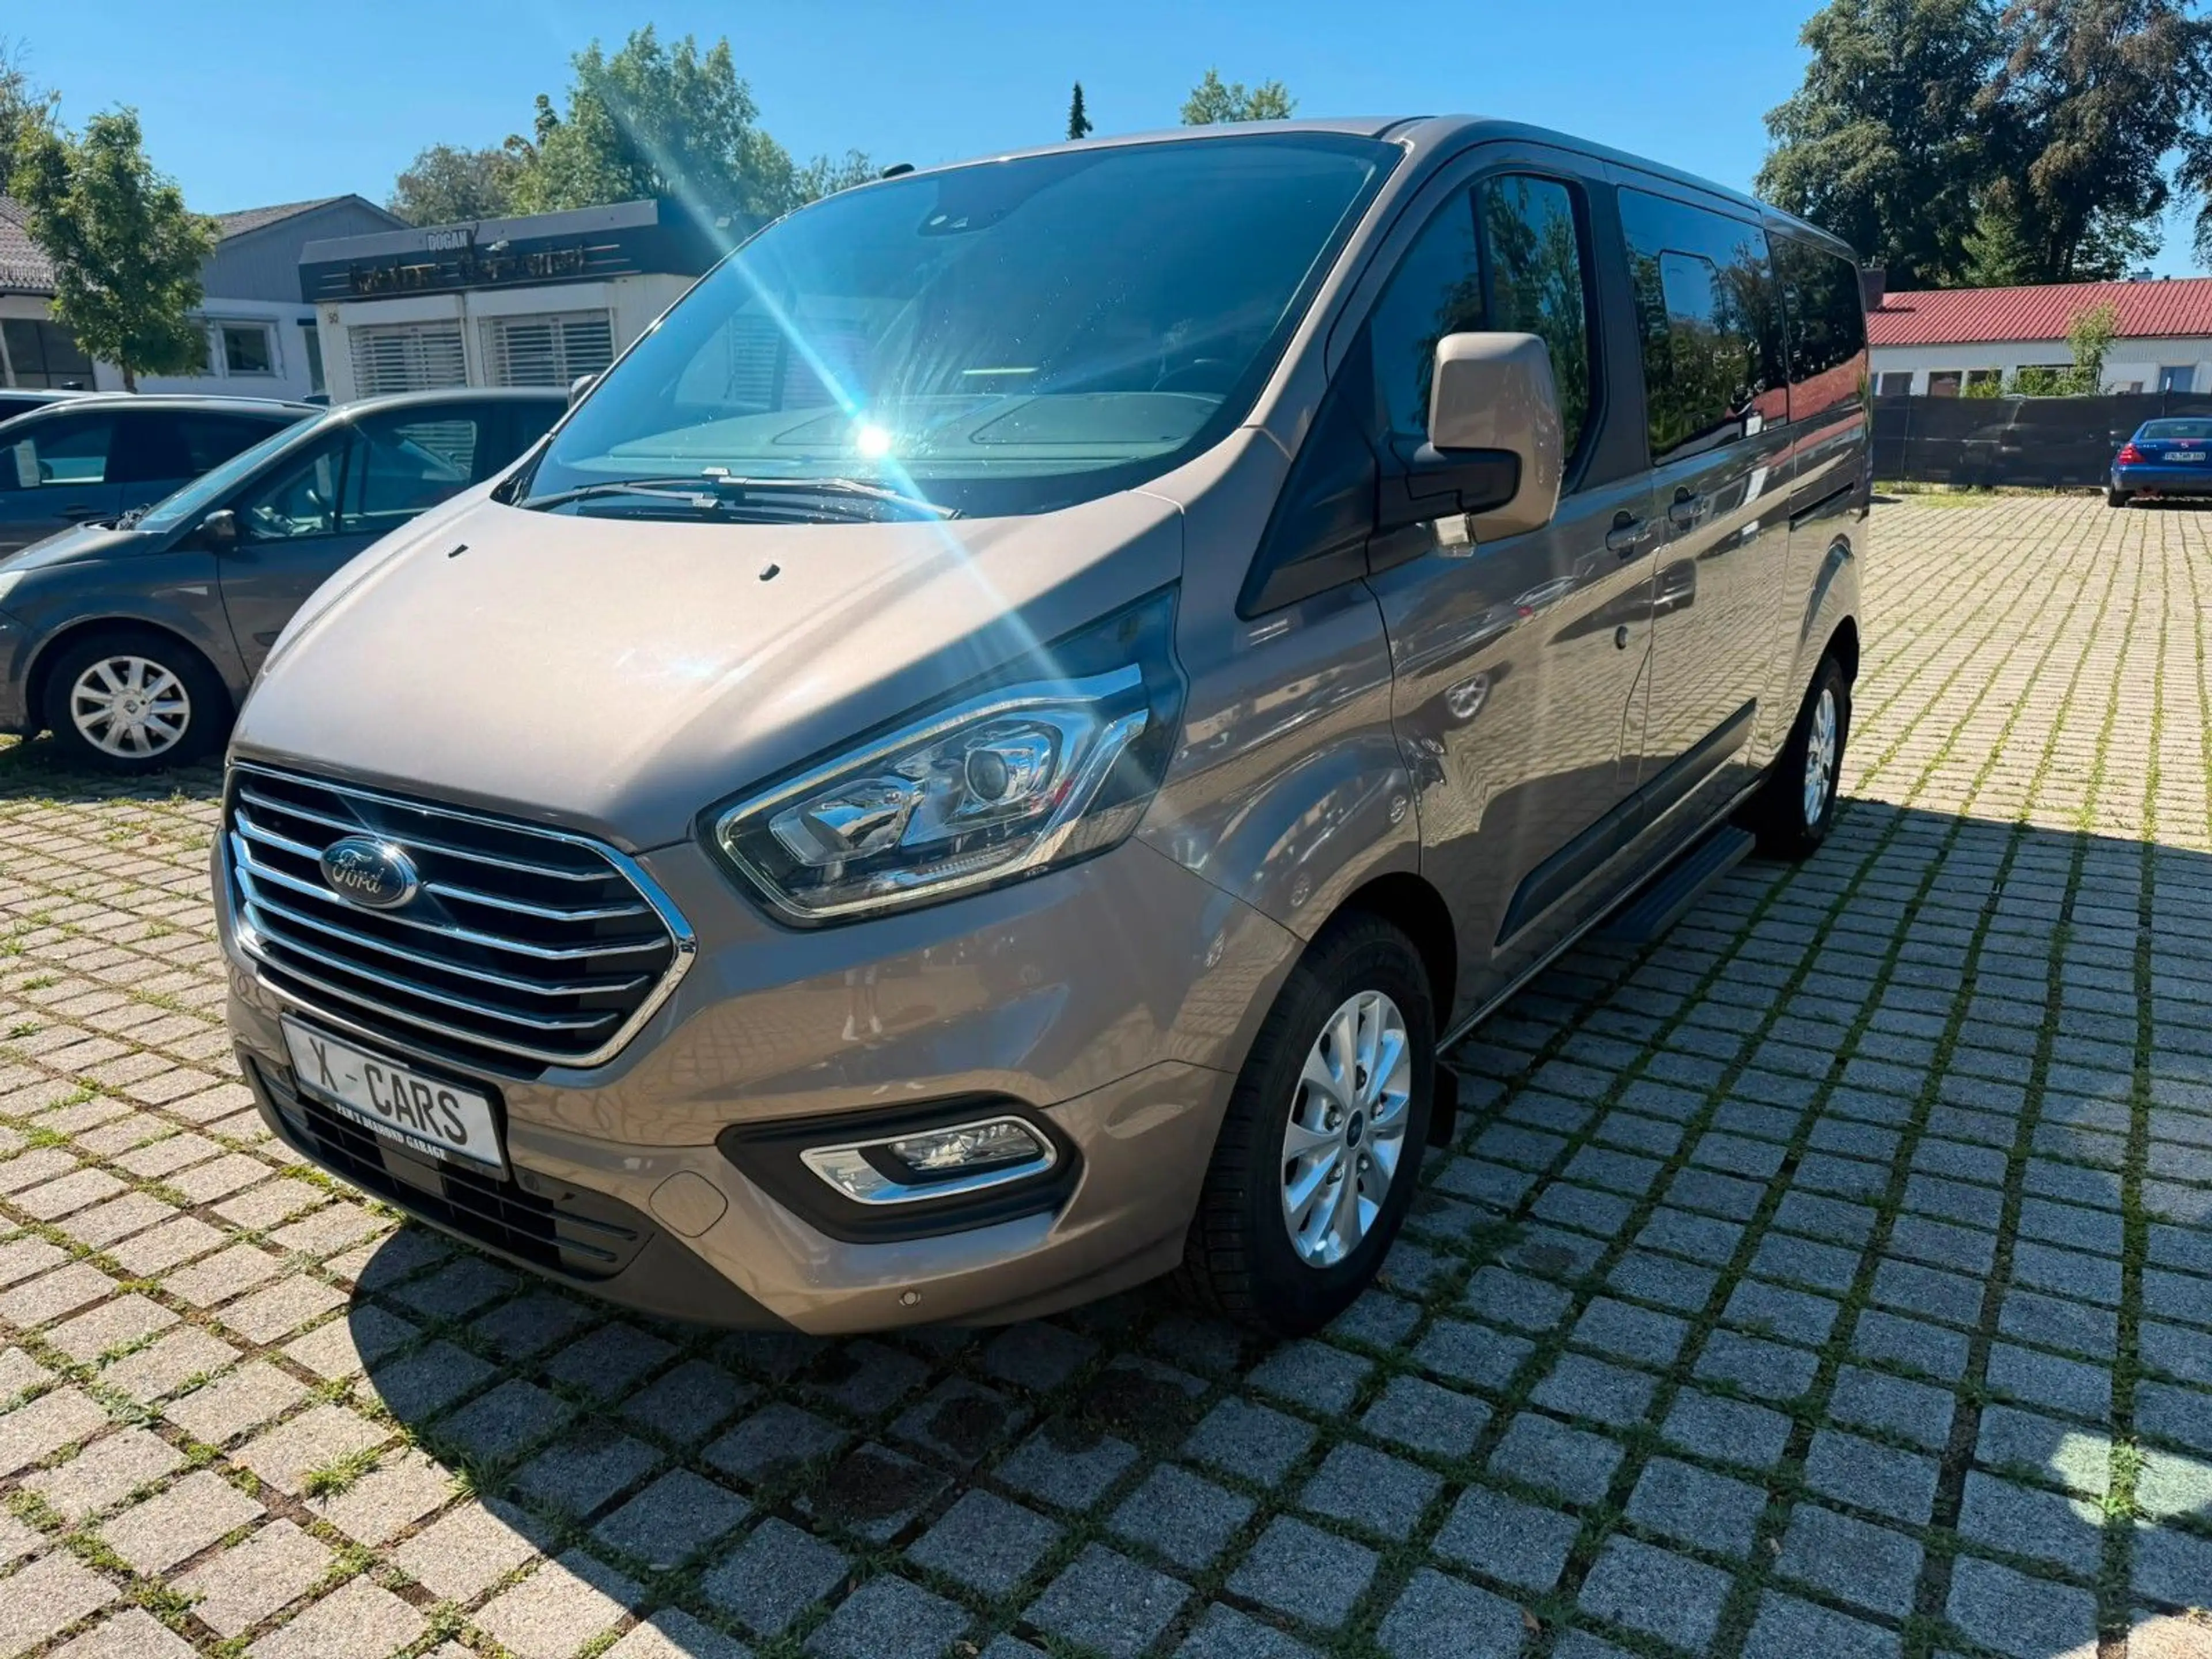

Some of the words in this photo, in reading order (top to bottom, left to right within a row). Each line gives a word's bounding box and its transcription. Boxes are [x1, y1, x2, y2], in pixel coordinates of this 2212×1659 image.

[428, 230, 467, 250] DOGAN
[333, 849, 385, 893] Ford
[309, 1037, 338, 1092] X
[364, 1063, 468, 1145] CARS
